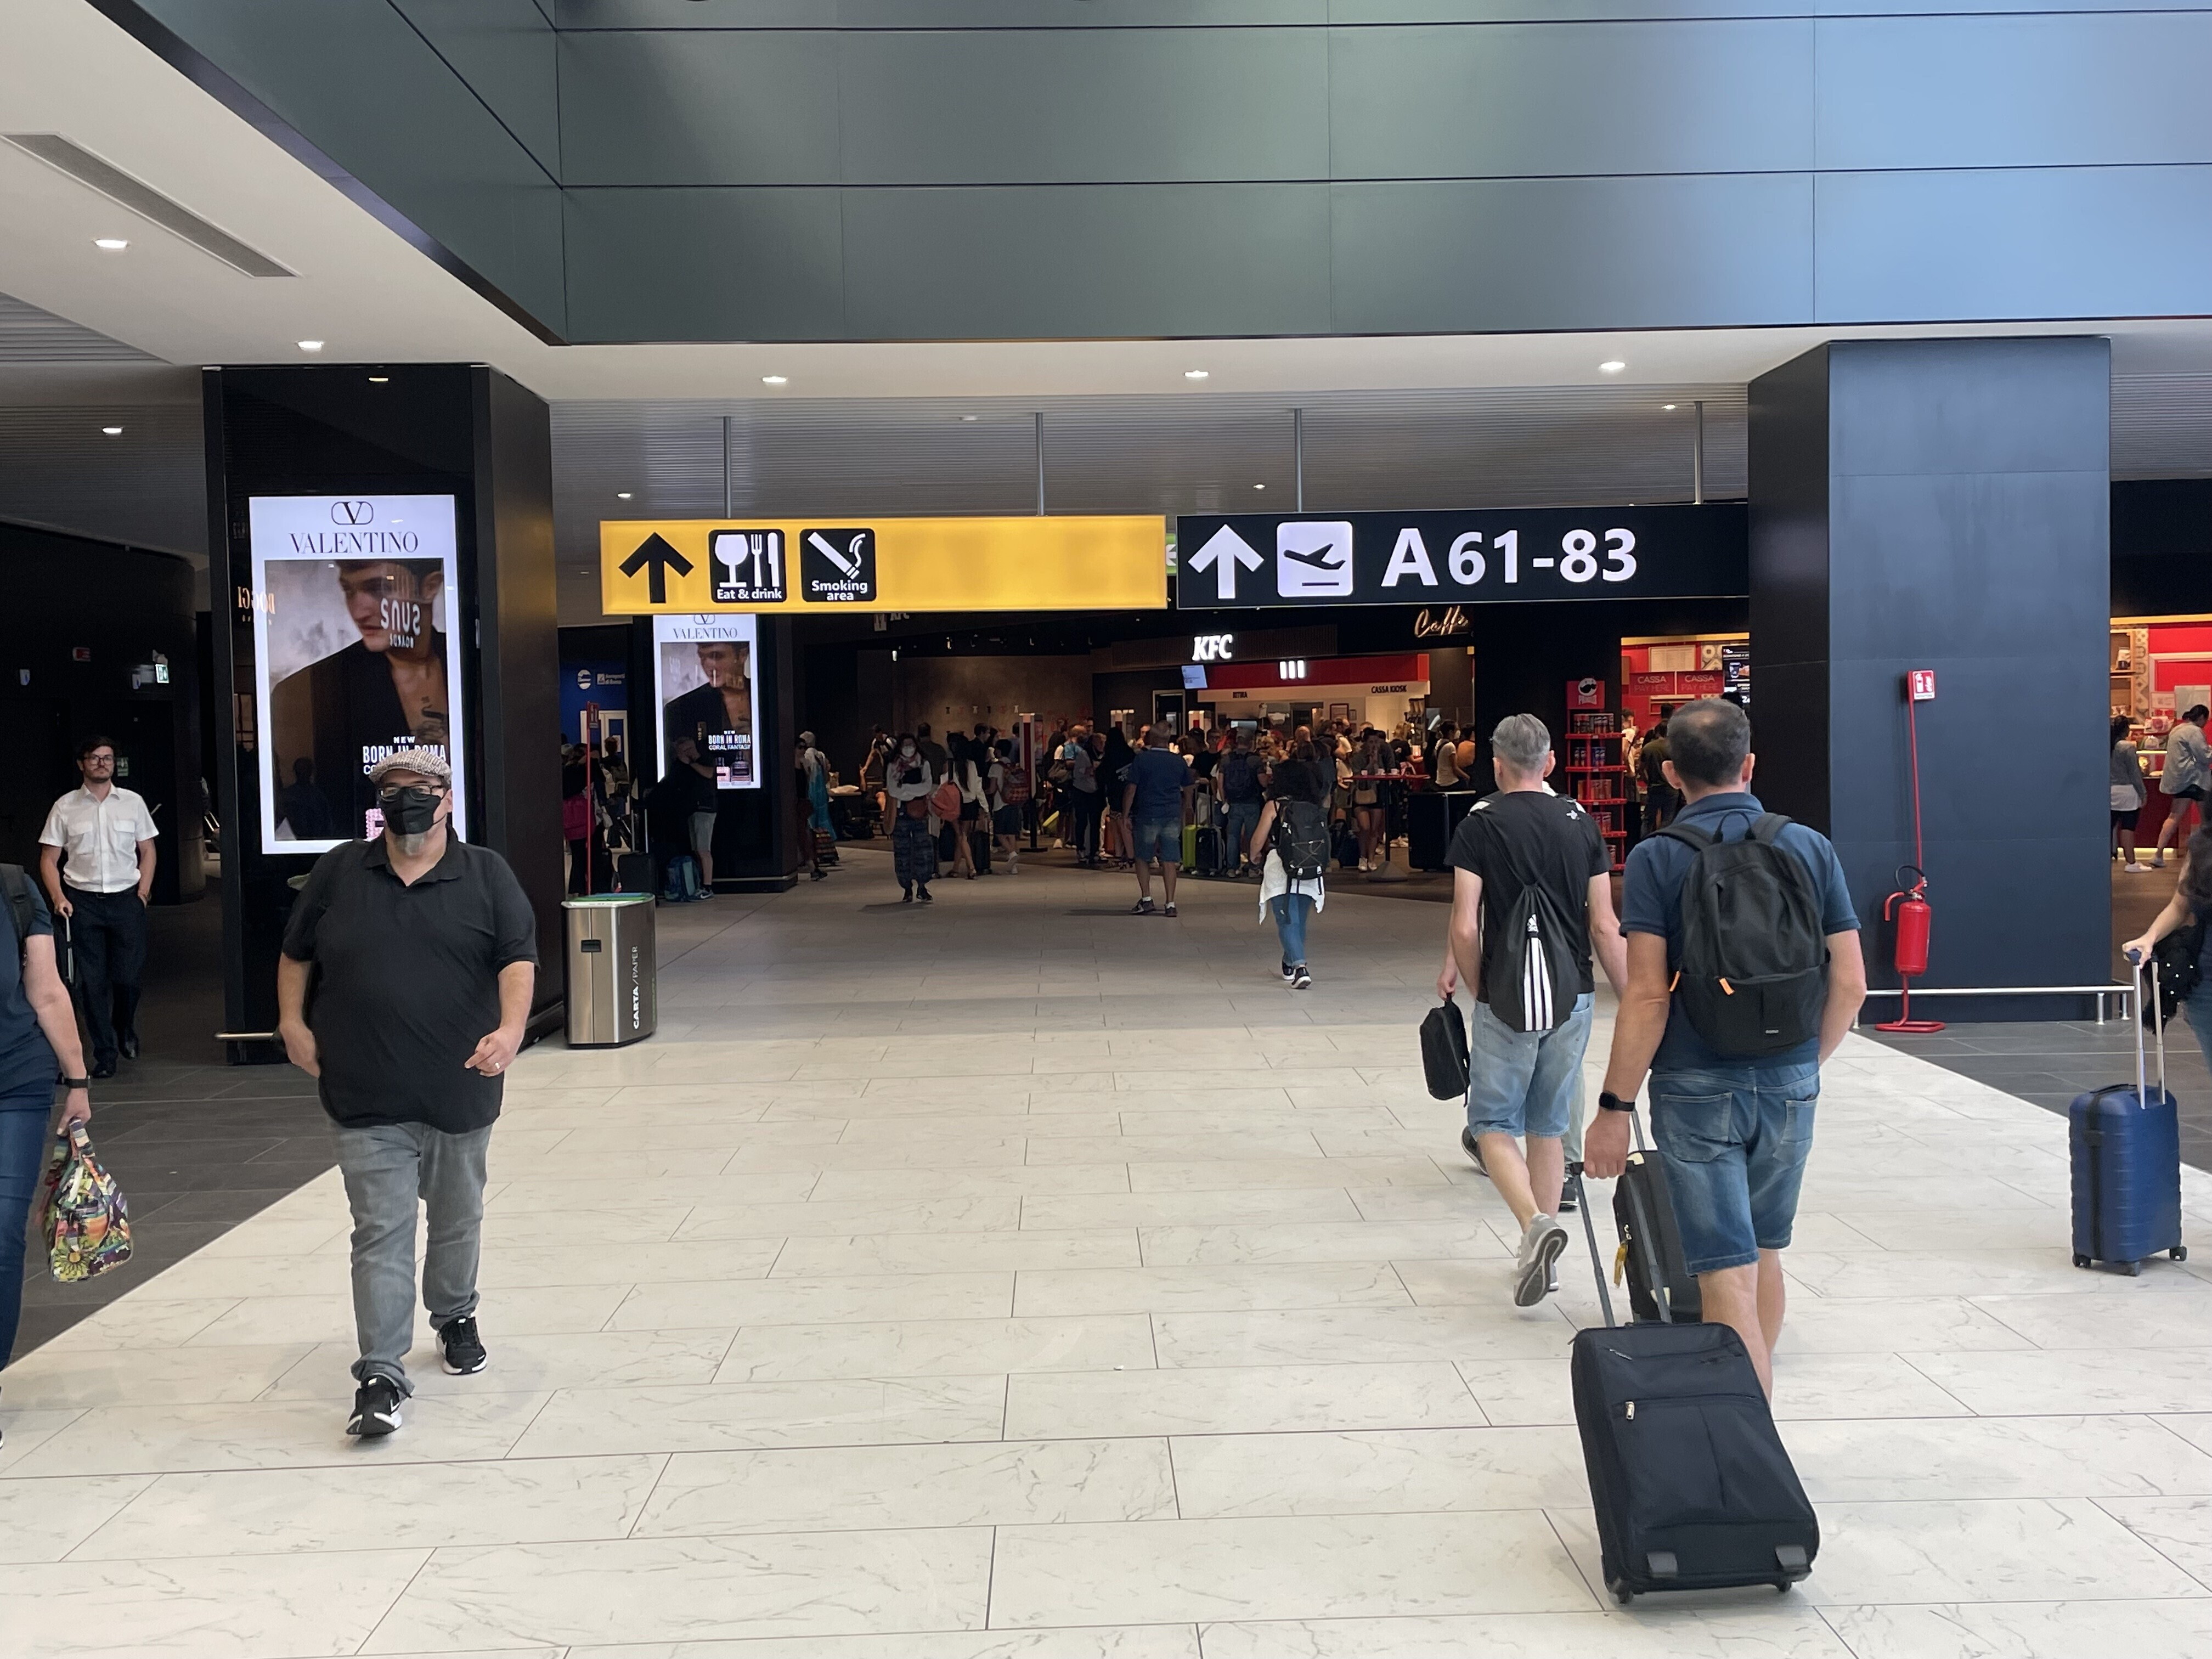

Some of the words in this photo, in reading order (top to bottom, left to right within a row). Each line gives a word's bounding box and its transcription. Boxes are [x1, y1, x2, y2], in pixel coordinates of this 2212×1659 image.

[289, 531, 419, 554] VALENTINO
[1381, 527, 1439, 587] A
[1448, 528, 1637, 585] 61-83
[812, 580, 868, 594] Smoking
[717, 589, 735, 599] Eat
[738, 589, 749, 599] &
[752, 589, 782, 599] drink
[827, 592, 854, 601] area
[673, 627, 738, 640] VALENTINO
[1192, 634, 1233, 661] KFC
[1637, 675, 1667, 684] CASSA
[1684, 674, 1715, 683] CASSA
[1372, 686, 1389, 694] CASSA
[1390, 685, 1407, 693] KIOSK
[708, 735, 725, 744] BORN
[726, 735, 733, 744] IN
[734, 734, 751, 744] ROMA
